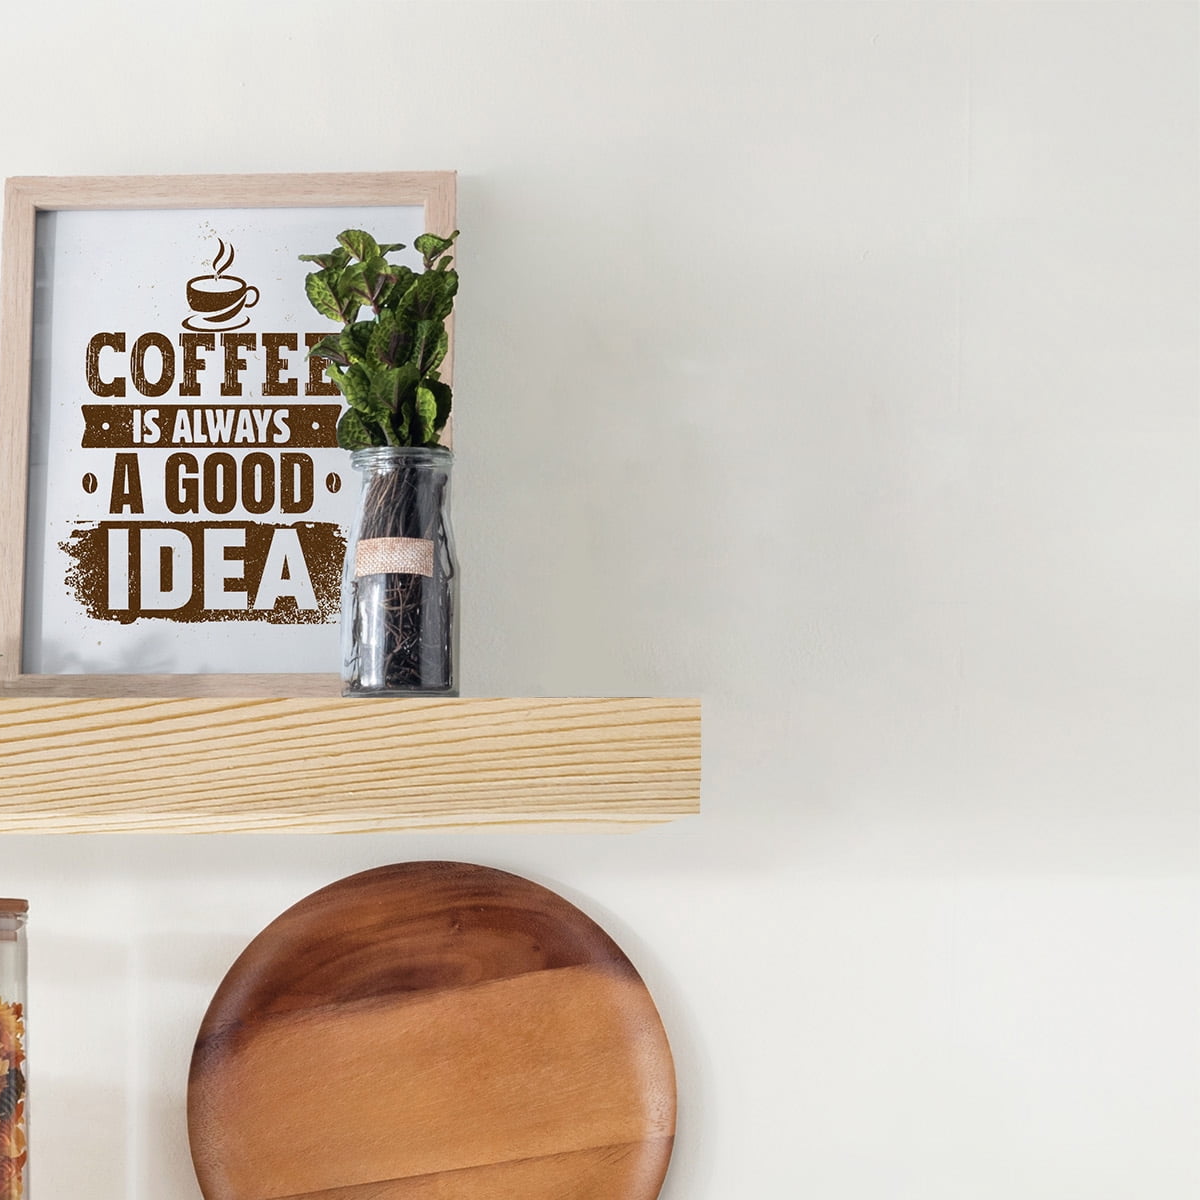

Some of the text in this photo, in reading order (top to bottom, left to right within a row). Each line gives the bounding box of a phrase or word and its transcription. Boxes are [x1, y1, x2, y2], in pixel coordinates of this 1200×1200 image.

[86, 332, 341, 396] COFFEE
[132, 408, 290, 444] IS ALWAYS
[109, 452, 314, 514] A GOOD
[107, 528, 318, 611] IDEA
